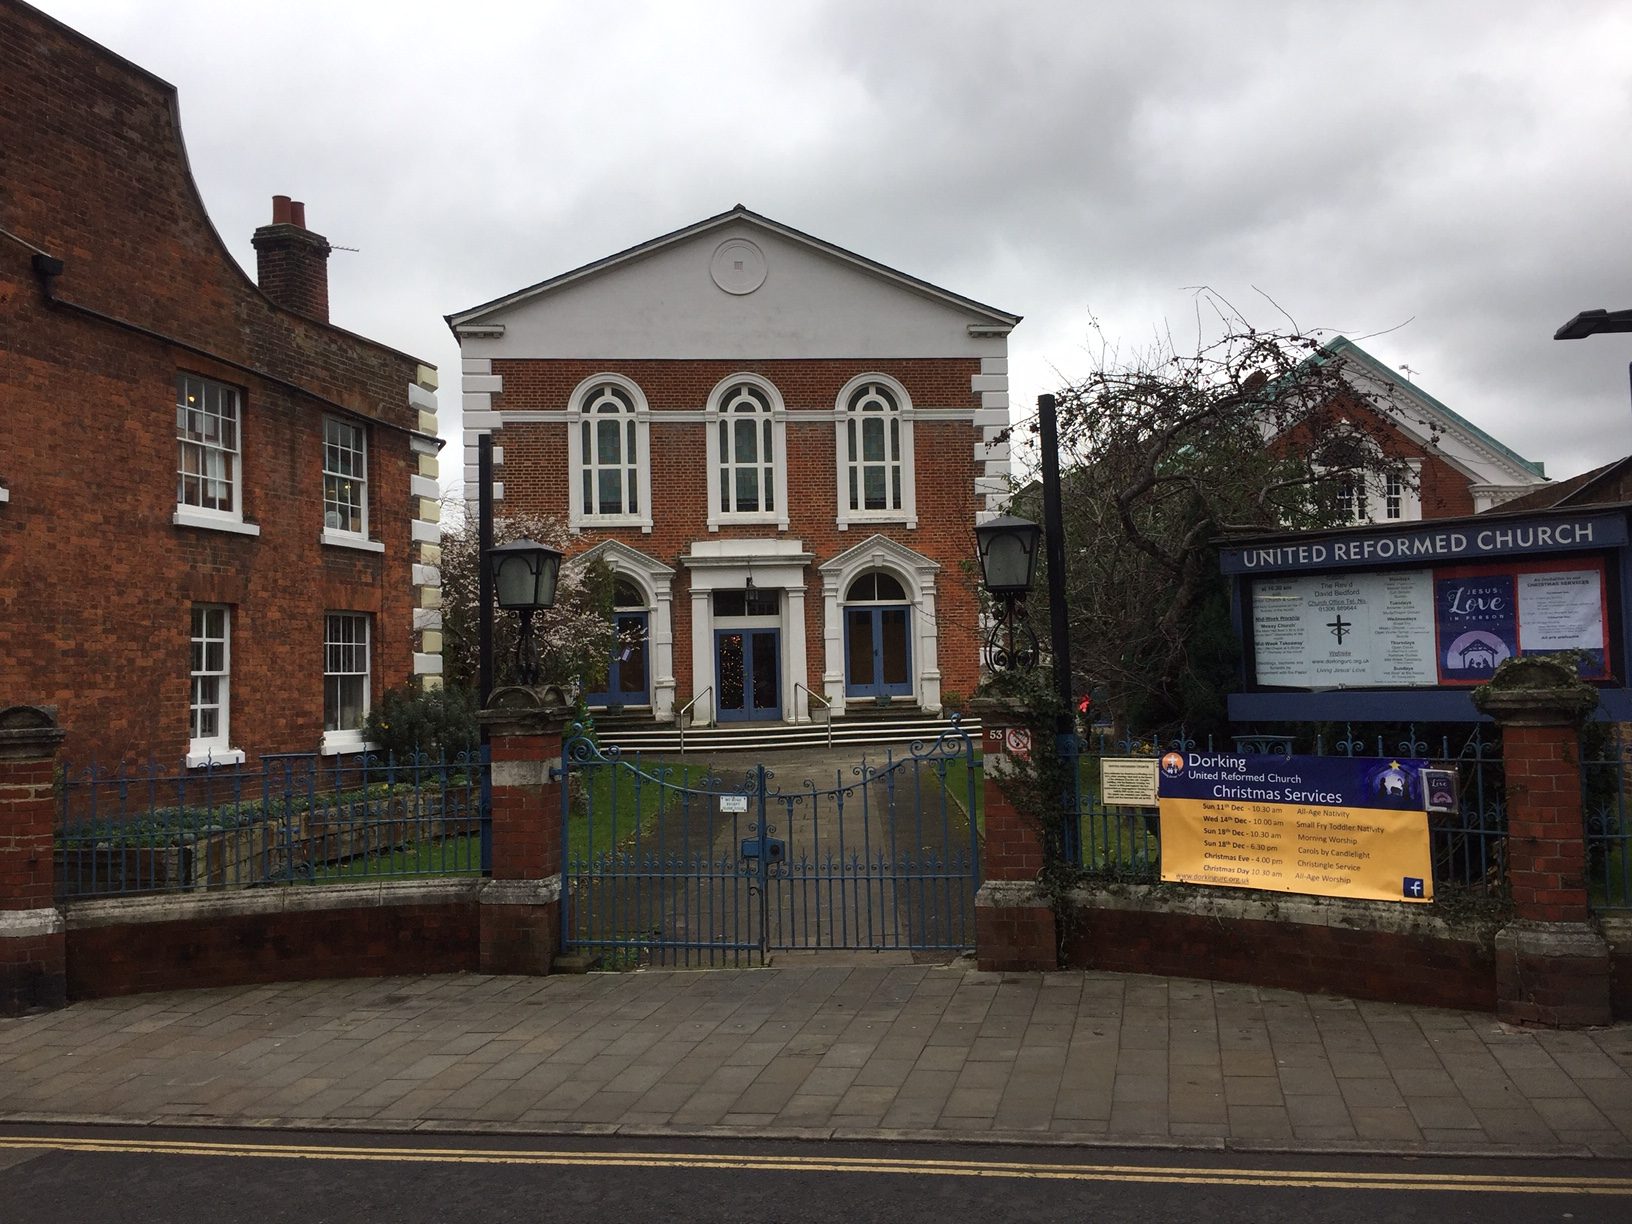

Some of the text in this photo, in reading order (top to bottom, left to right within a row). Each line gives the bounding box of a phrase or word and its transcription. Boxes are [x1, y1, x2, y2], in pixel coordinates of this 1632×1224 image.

[1244, 523, 1593, 567] UNITED REFORMED CHURCH
[1447, 587, 1505, 614] Love
[990, 730, 1003, 740] 53
[1189, 754, 1246, 772] Dorking
[1188, 770, 1218, 780] United
[1221, 771, 1265, 782] Reformed
[1268, 774, 1302, 783] Church
[1213, 785, 1343, 803] Christmas Services
[1297, 808, 1350, 818] All-Age Nativity
[1329, 823, 1356, 832] Toddler
[1357, 825, 1384, 834] Nativity
[1298, 834, 1357, 845] Morning Worship
[1204, 852, 1236, 861] Christmas
[1298, 847, 1319, 855] Carols
[1331, 850, 1370, 859] Candlelight
[1204, 864, 1235, 873] Christmas
[1297, 860, 1360, 871] Christingle Service
[1295, 873, 1351, 884] All-Age Worship
